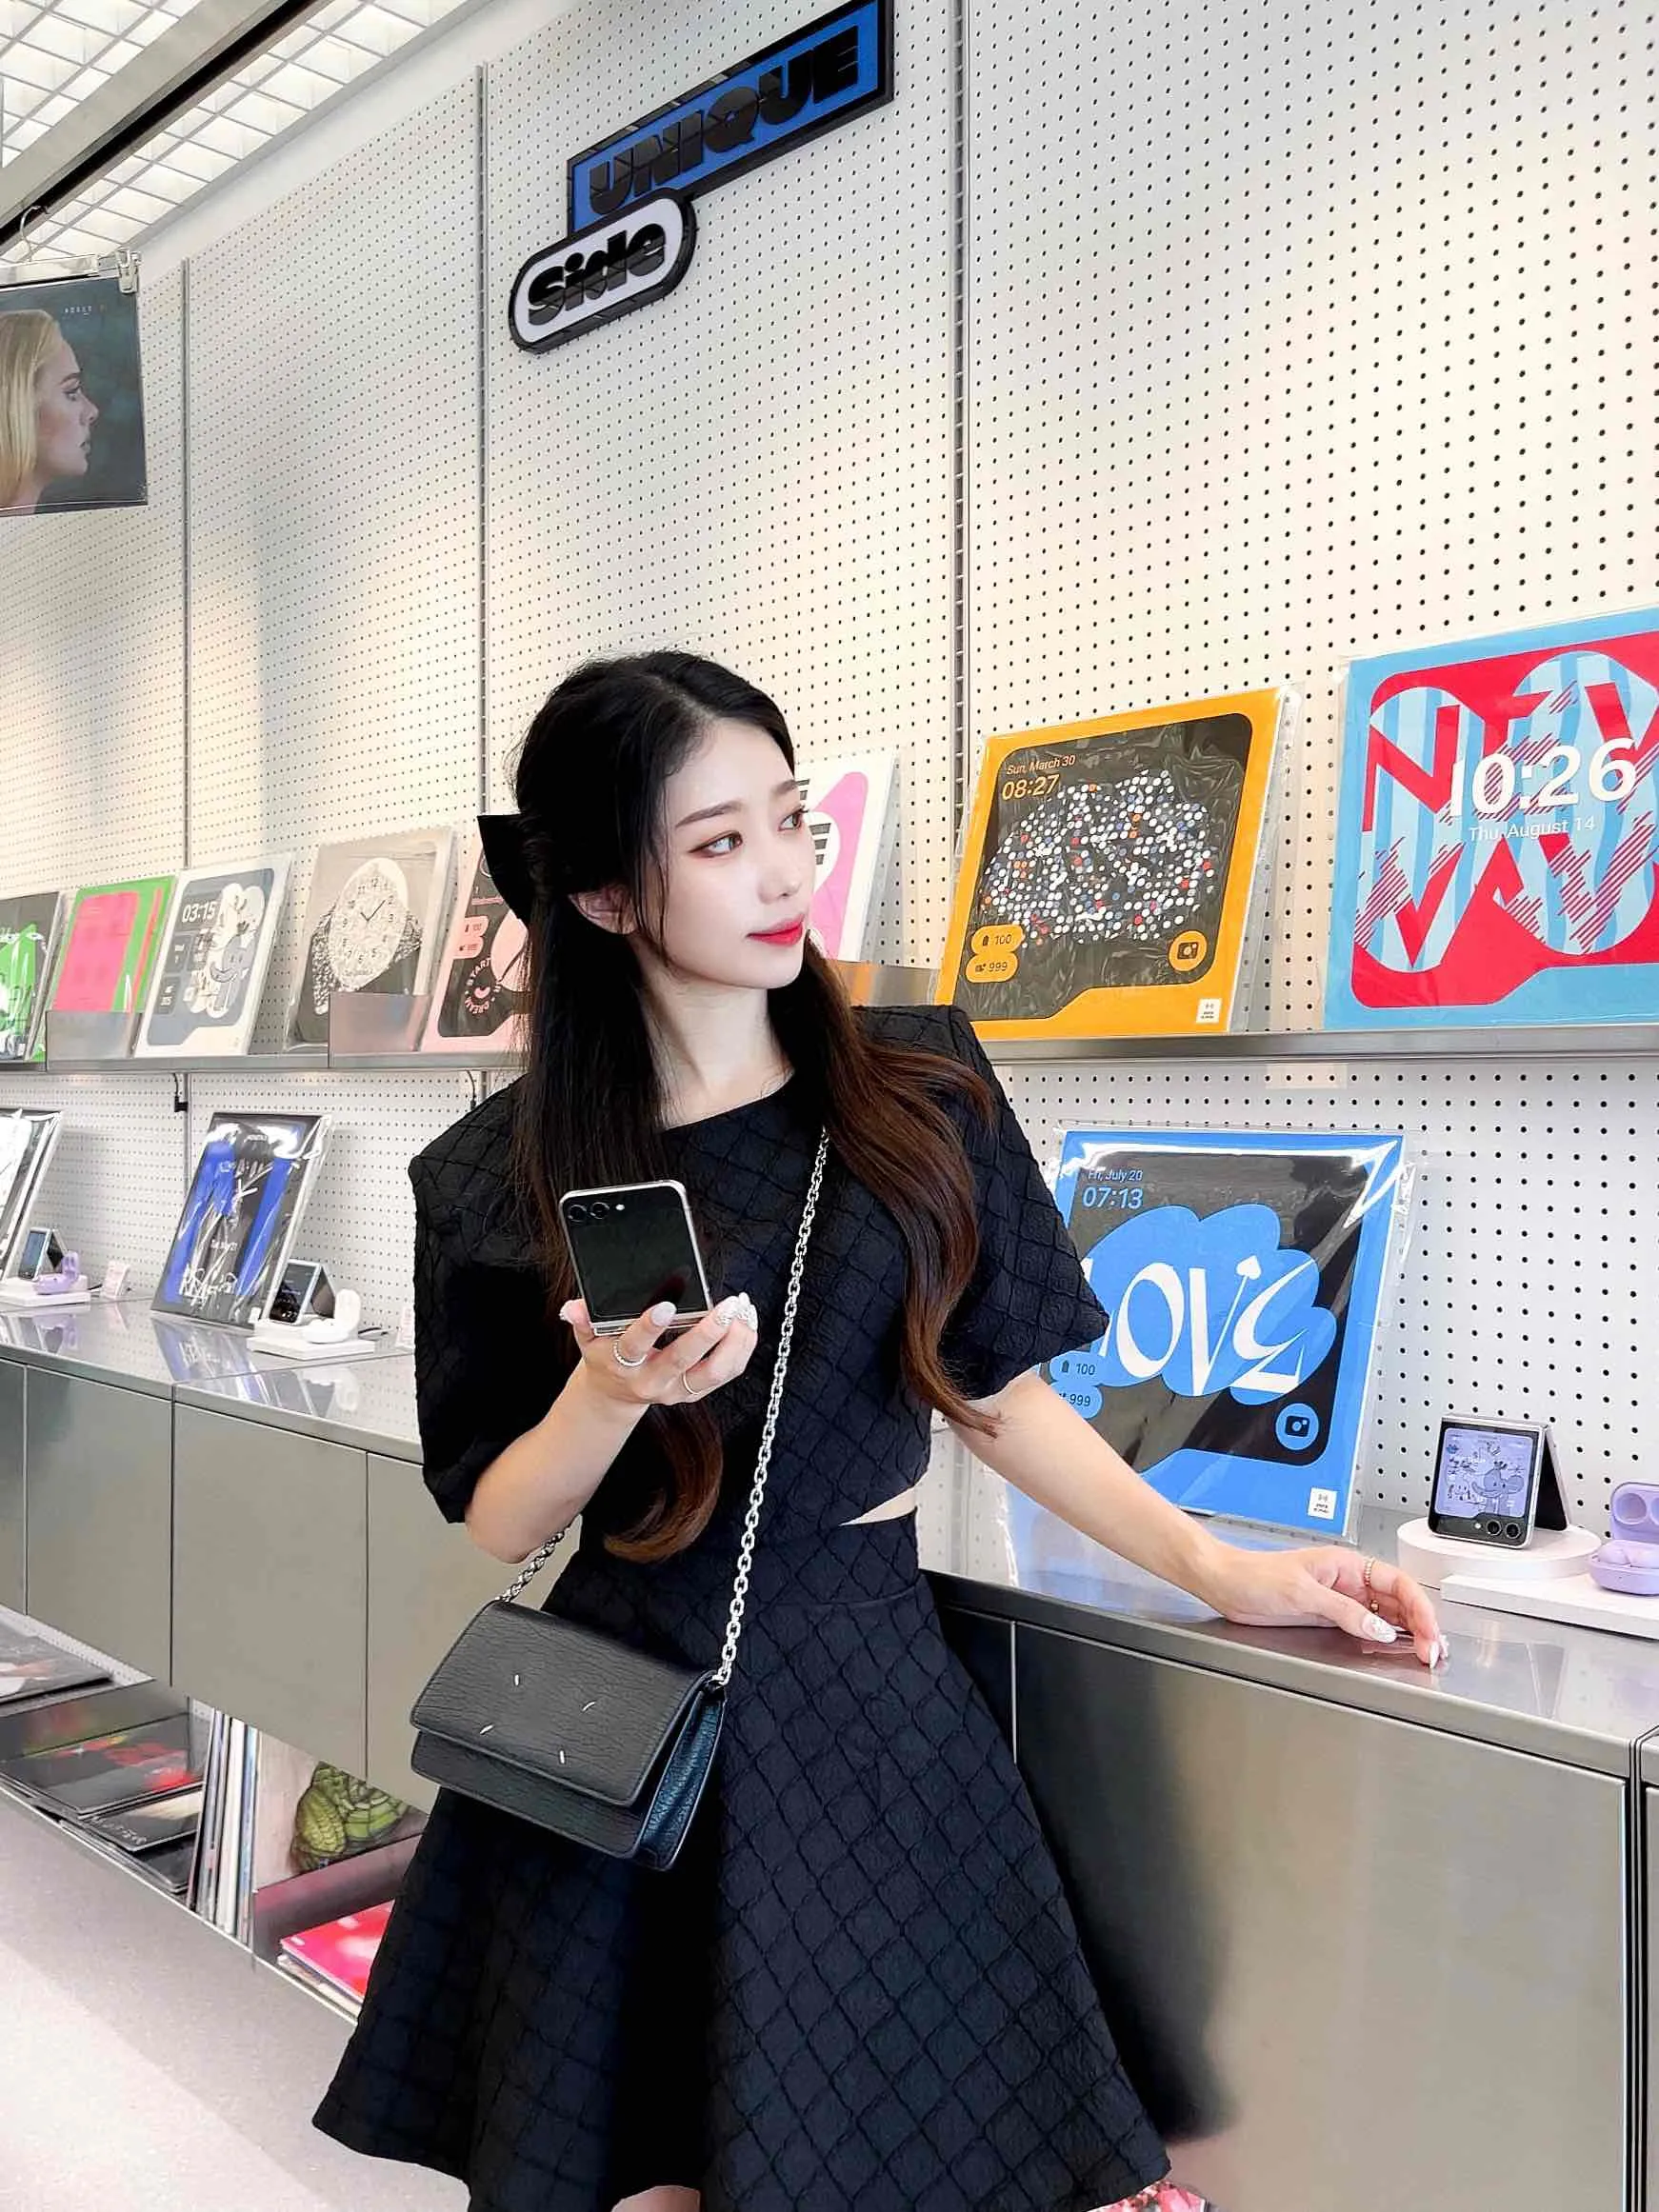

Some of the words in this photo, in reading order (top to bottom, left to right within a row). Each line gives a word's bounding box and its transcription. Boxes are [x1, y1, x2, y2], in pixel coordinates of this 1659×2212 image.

[589, 25, 860, 215] UNIQUE
[1029, 758, 1060, 772] March
[1062, 754, 1076, 767] 30
[1002, 773, 1060, 801] 08:27
[1449, 737, 1637, 817] 10:26
[1575, 815, 1595, 831] 14
[1105, 1169, 1127, 1183] July
[1128, 1170, 1143, 1181] 20
[1082, 1186, 1143, 1209] 07:13
[1081, 1254, 1316, 1396] OVE
[1076, 1364, 1095, 1375] 100
[1069, 1393, 1091, 1406] 999
